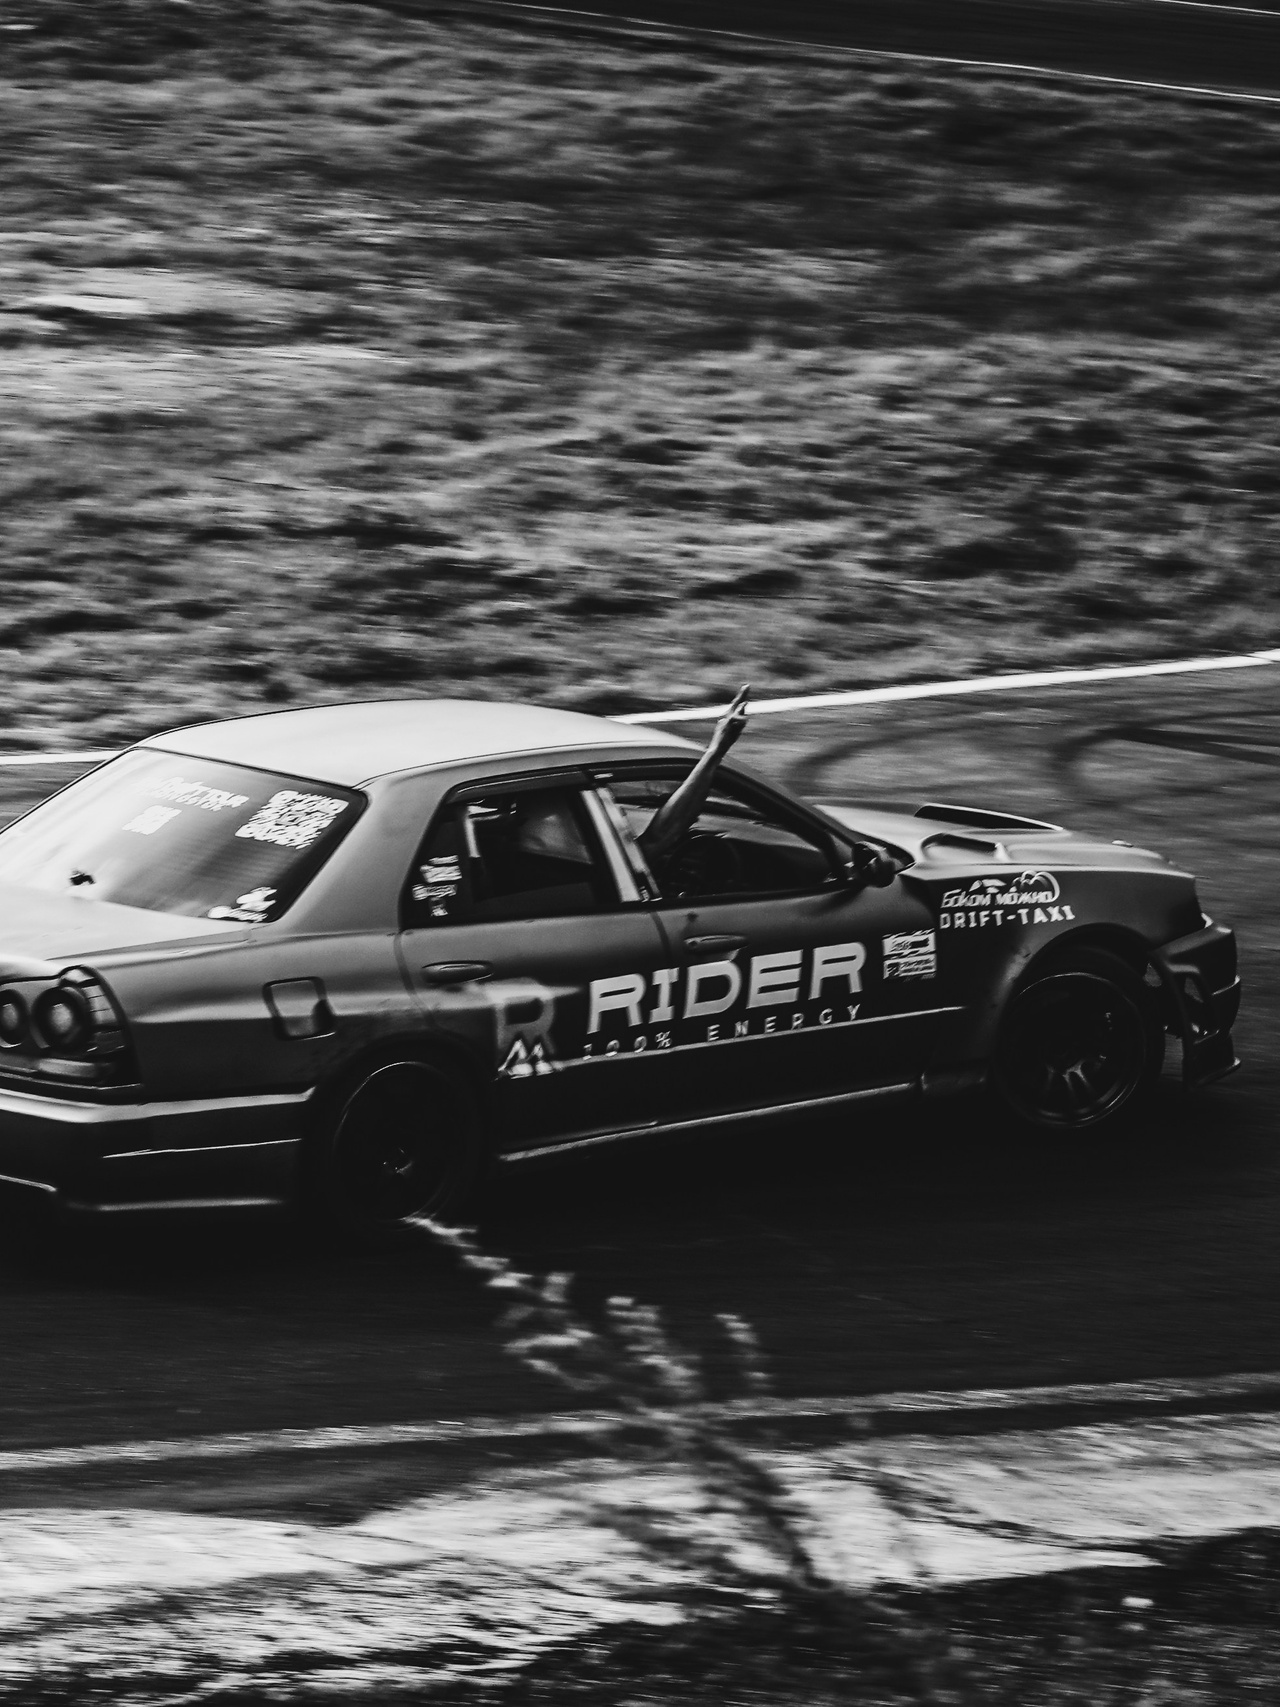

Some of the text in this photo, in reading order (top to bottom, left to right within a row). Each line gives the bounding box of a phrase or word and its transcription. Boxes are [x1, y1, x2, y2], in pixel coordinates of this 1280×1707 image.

[939, 905, 1076, 930] DRIFT-TAXI
[586, 941, 867, 1035] RIDER
[582, 1003, 862, 1061] 100% ENERGY
